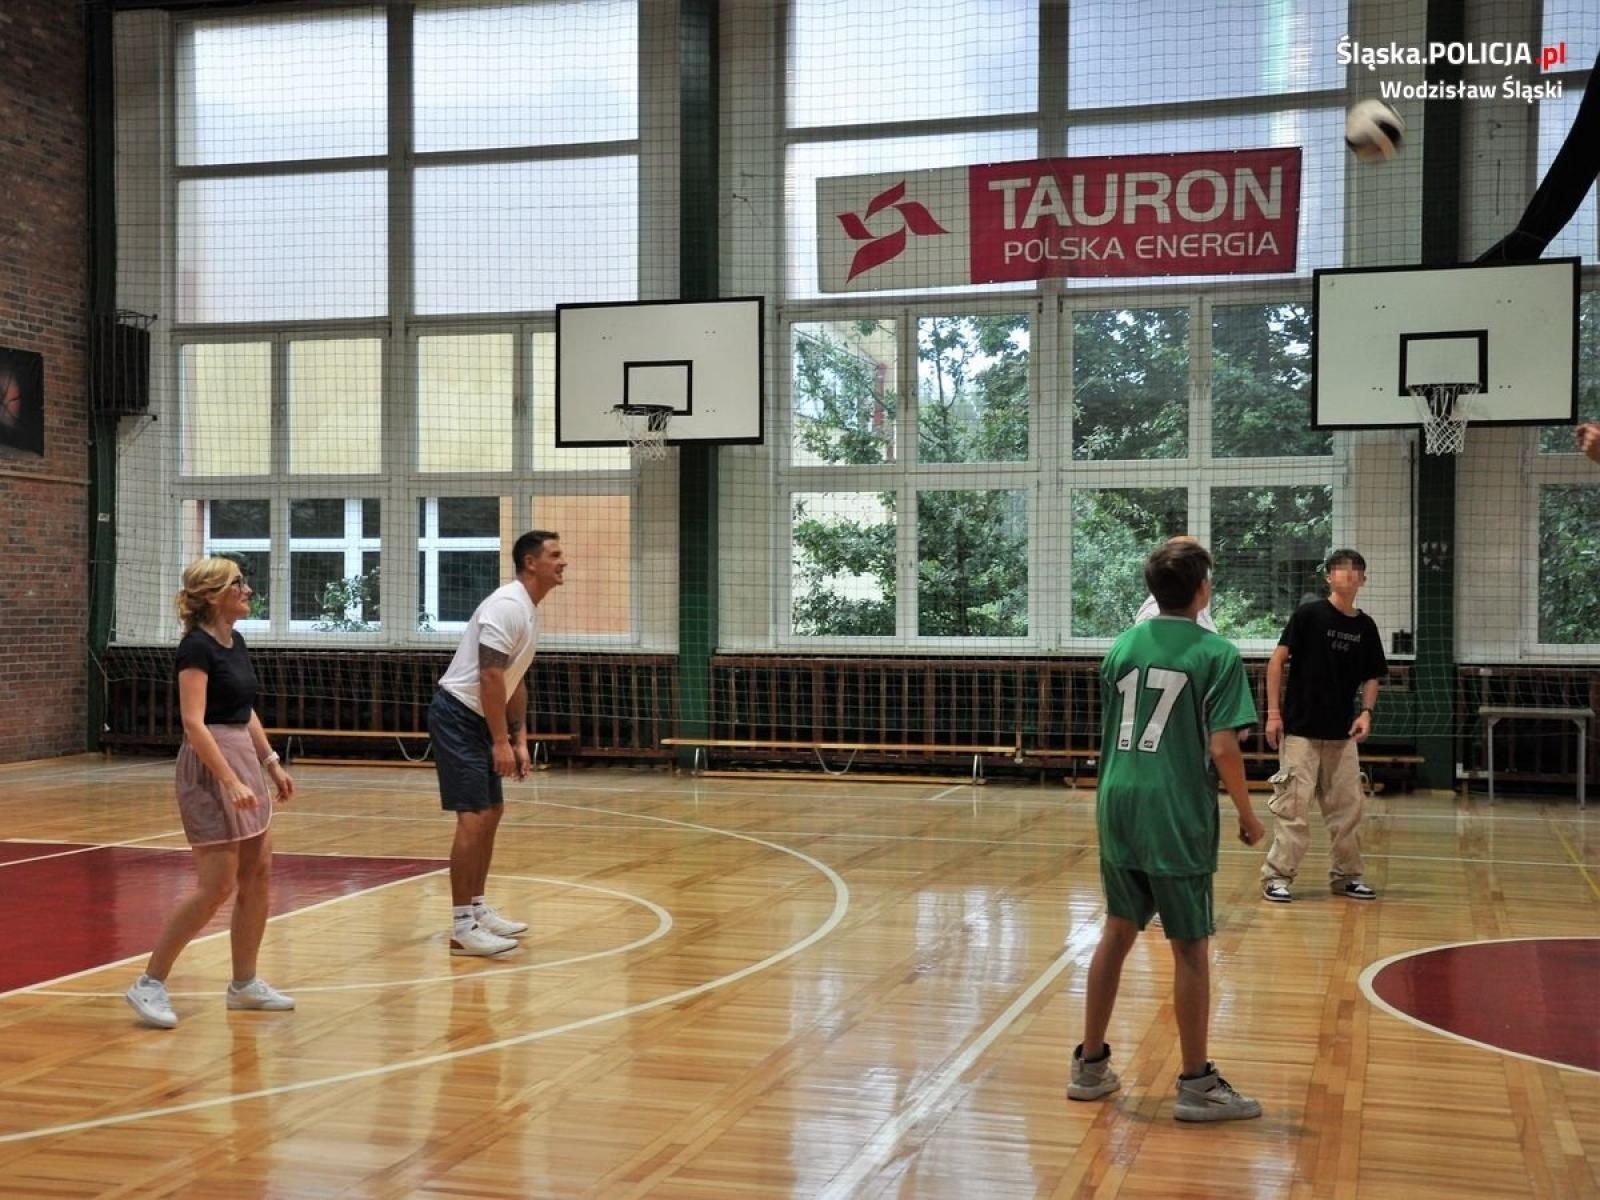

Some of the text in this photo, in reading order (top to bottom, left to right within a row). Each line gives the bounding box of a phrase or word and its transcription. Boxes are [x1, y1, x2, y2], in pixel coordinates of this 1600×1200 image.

[988, 165, 1283, 230] TAURON
[1003, 230, 1280, 264] POLSKA ENERGIA
[1115, 667, 1189, 753] 17
